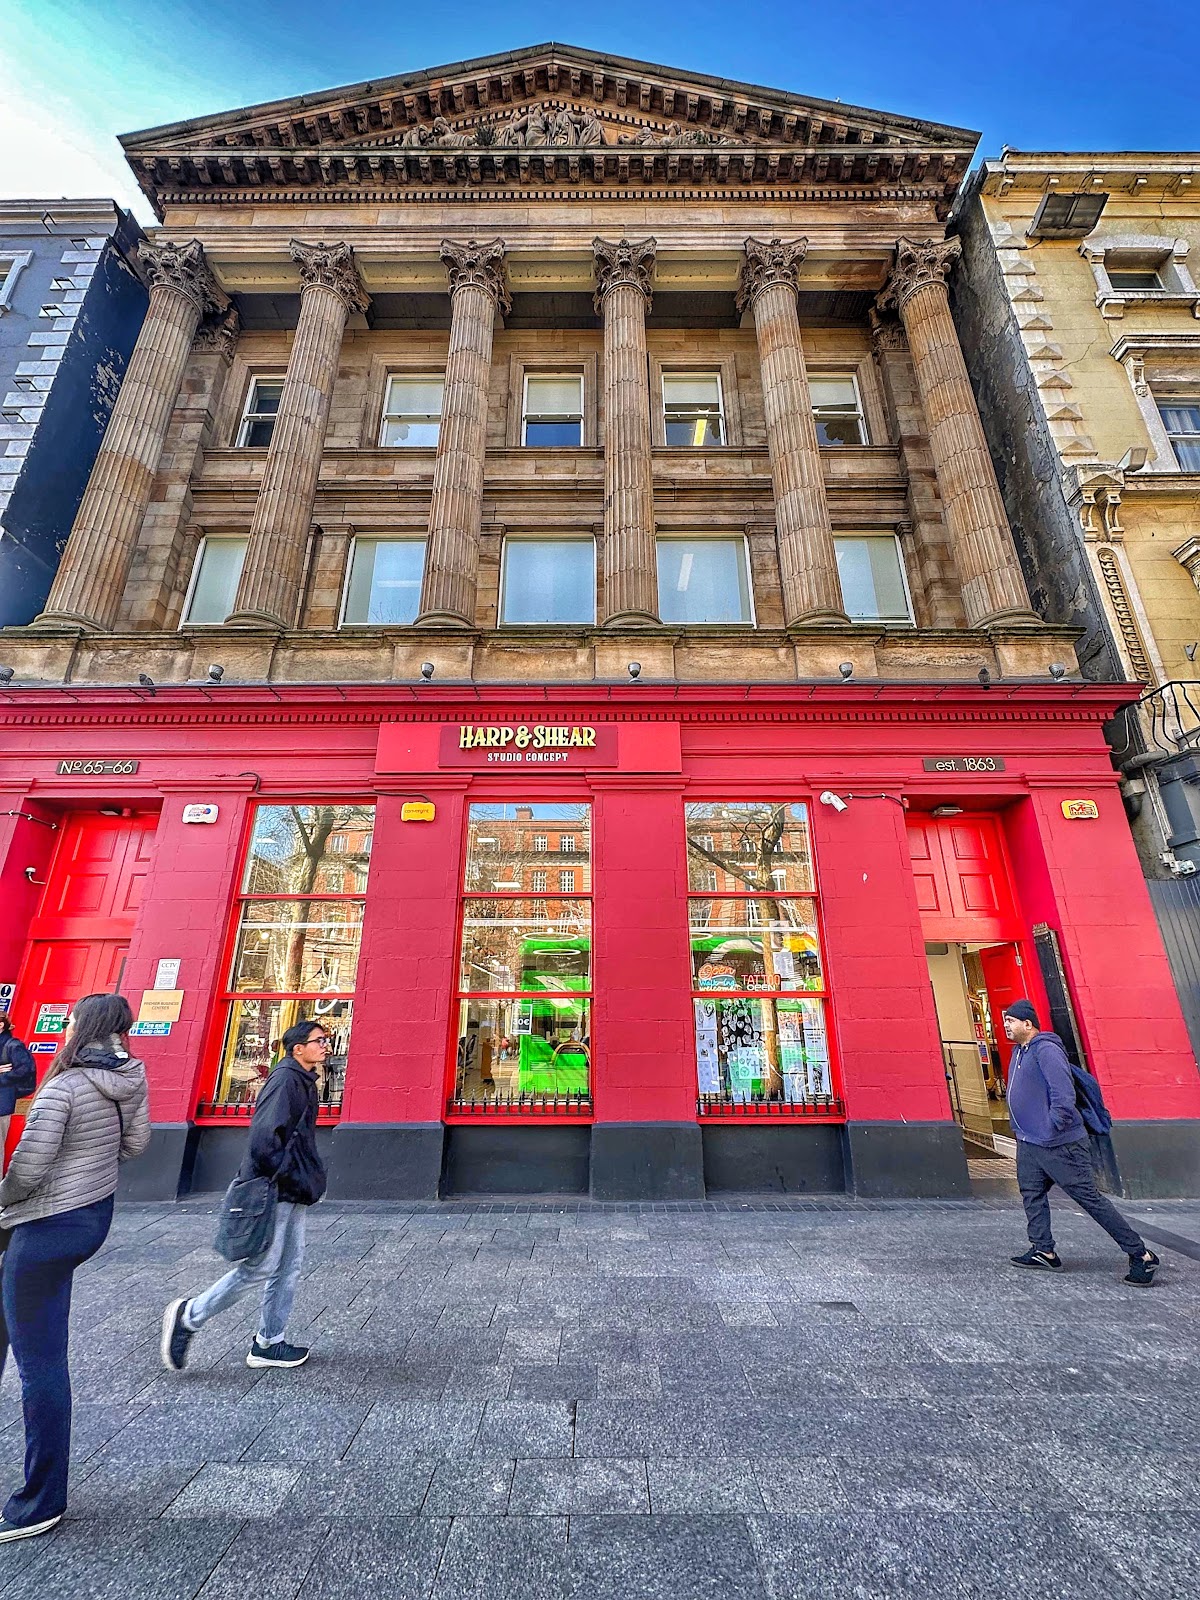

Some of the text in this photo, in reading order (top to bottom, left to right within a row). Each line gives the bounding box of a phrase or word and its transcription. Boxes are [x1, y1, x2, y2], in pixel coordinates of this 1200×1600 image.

[459, 725, 514, 748] HARP
[532, 725, 597, 748] SHEAR
[487, 752, 568, 762] STUDIO CONCEPT
[935, 757, 996, 771] est. 1863
[741, 974, 780, 985] TATTOO
[746, 983, 776, 991] OPEN
